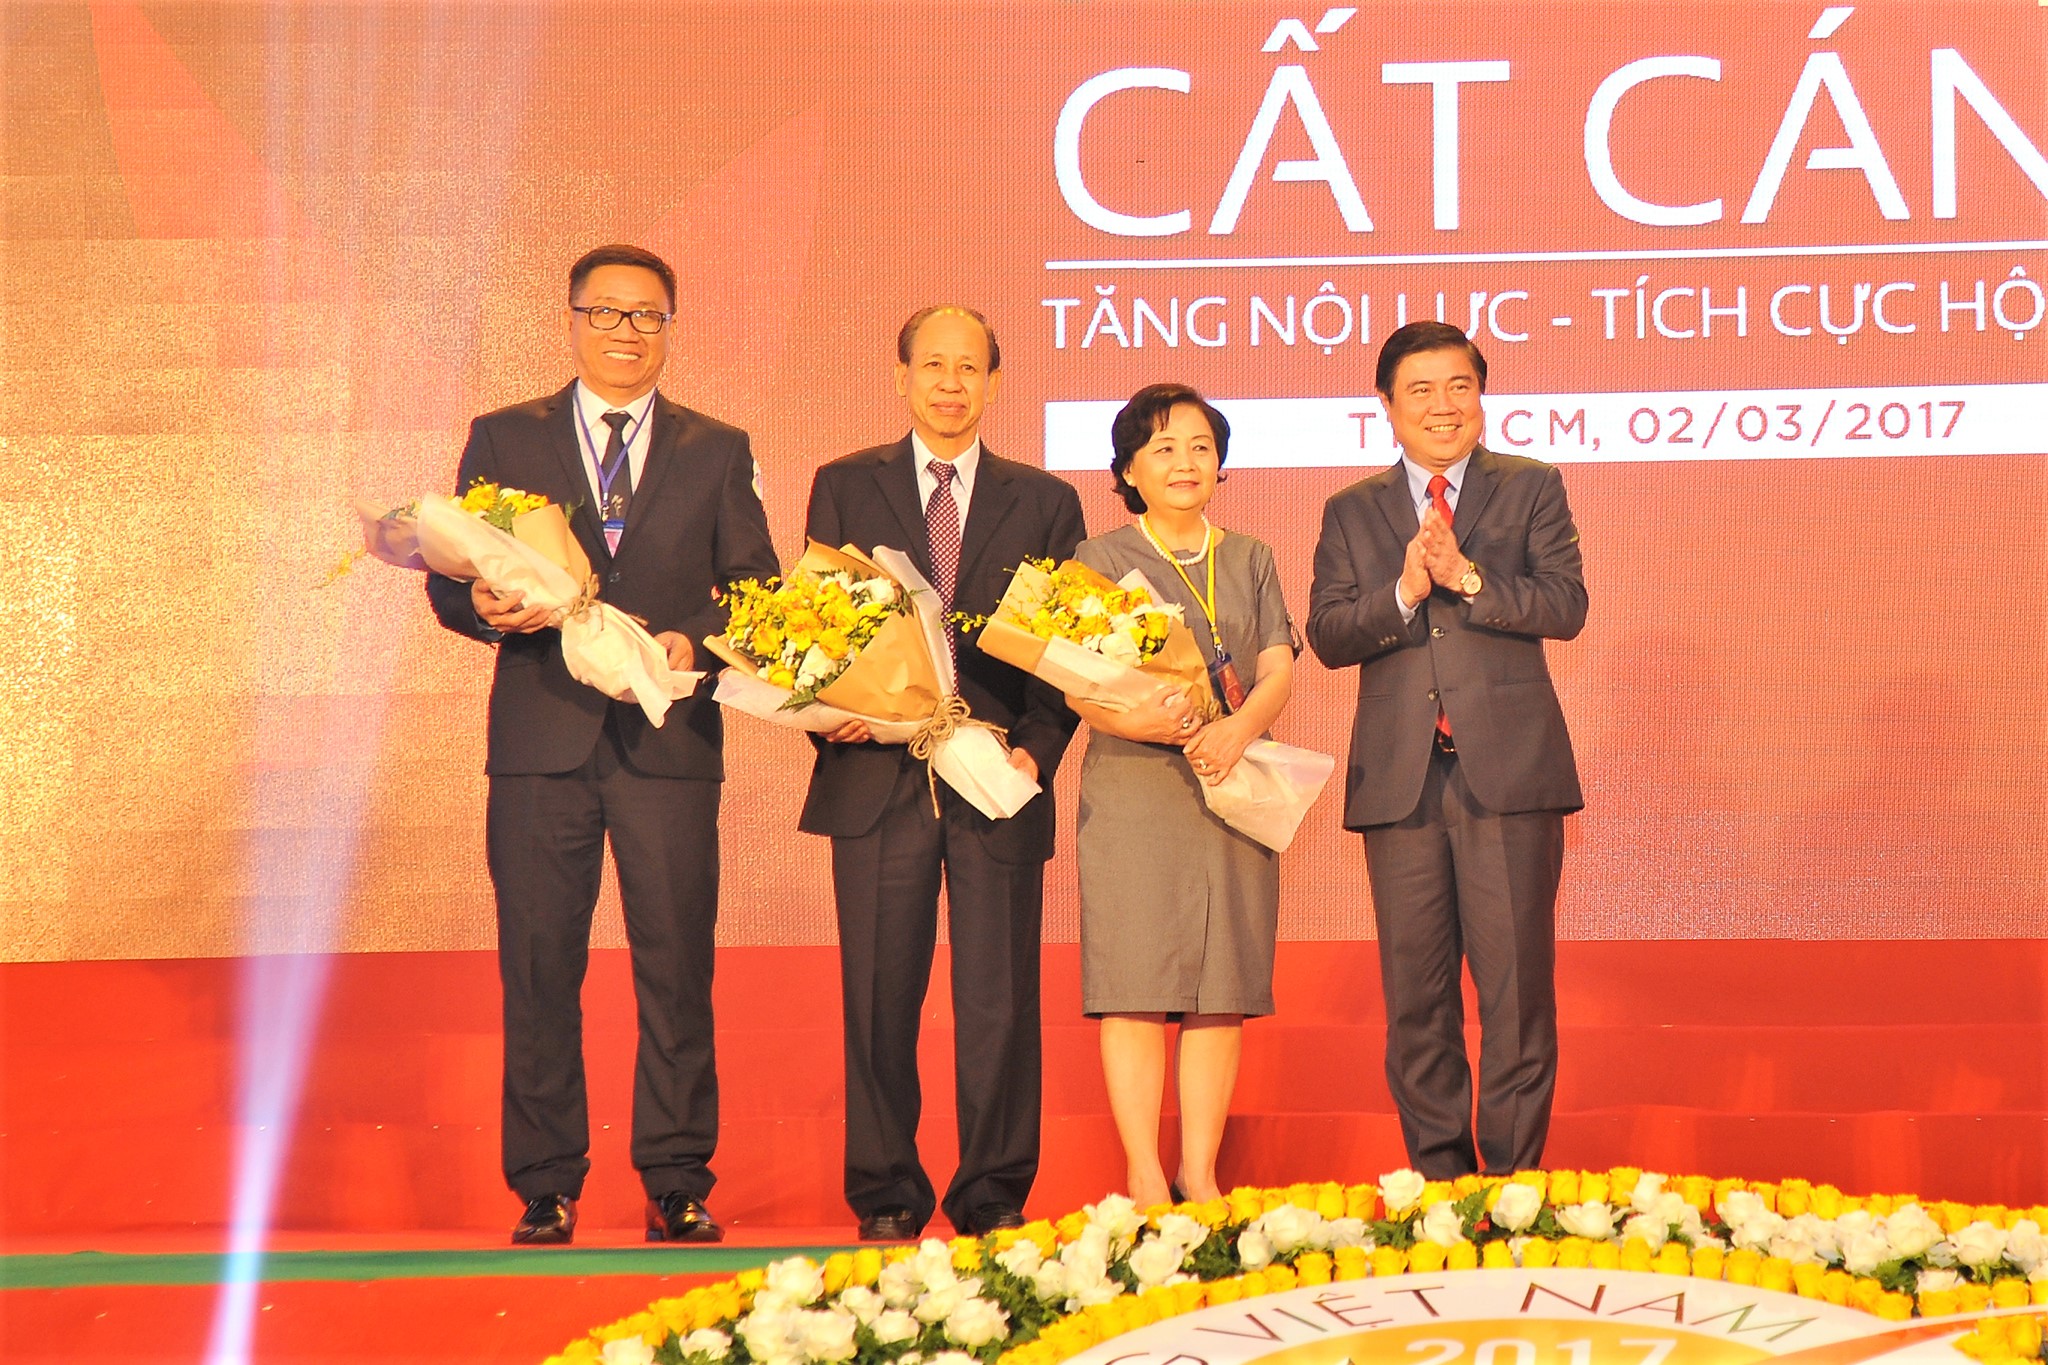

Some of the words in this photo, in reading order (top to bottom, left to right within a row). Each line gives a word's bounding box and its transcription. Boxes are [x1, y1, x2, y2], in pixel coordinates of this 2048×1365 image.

[1053, 7, 1511, 237] CẤT
[1040, 284, 1228, 349] TĂNG
[1250, 281, 1370, 355] NỘI
[1590, 274, 1748, 341] TÍCH
[1770, 282, 1917, 345] CỰC
[1940, 264, 2047, 341] HỘ
[1628, 400, 1967, 449] 02/03/2017
[1192, 1285, 1445, 1342] VIỆT
[1518, 1282, 1819, 1342] NAM
